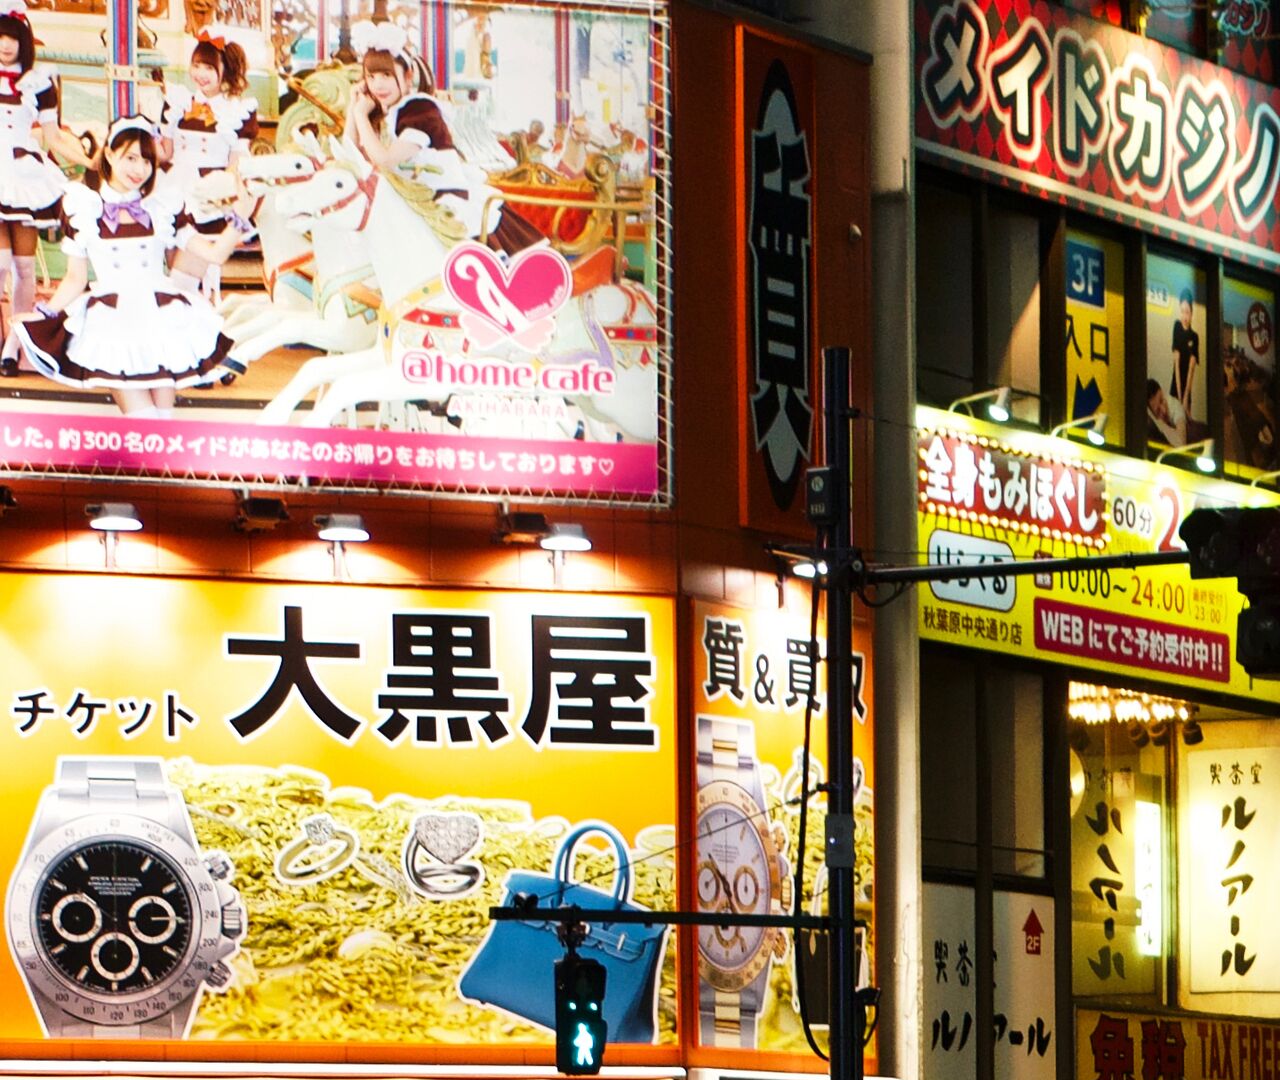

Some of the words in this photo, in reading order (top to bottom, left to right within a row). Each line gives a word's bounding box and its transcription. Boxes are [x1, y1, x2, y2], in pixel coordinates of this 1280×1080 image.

[1071, 252, 1100, 296] 3F
[402, 352, 533, 388] @home
[542, 362, 613, 393] cafe
[451, 399, 565, 418] AKIHABARA
[923, 434, 1100, 534] 全身もみほぐし
[922, 605, 1023, 646] 秋葉原中央通り店
[1041, 610, 1083, 649] WEB
[227, 605, 658, 747] 大黒屋
[14, 690, 196, 738] チケット
[1209, 761, 1262, 786] 喫茶室
[1219, 795, 1258, 978] ルノアール
[1025, 938, 1041, 954] 2F
[1198, 1021, 1235, 1080] TAX
